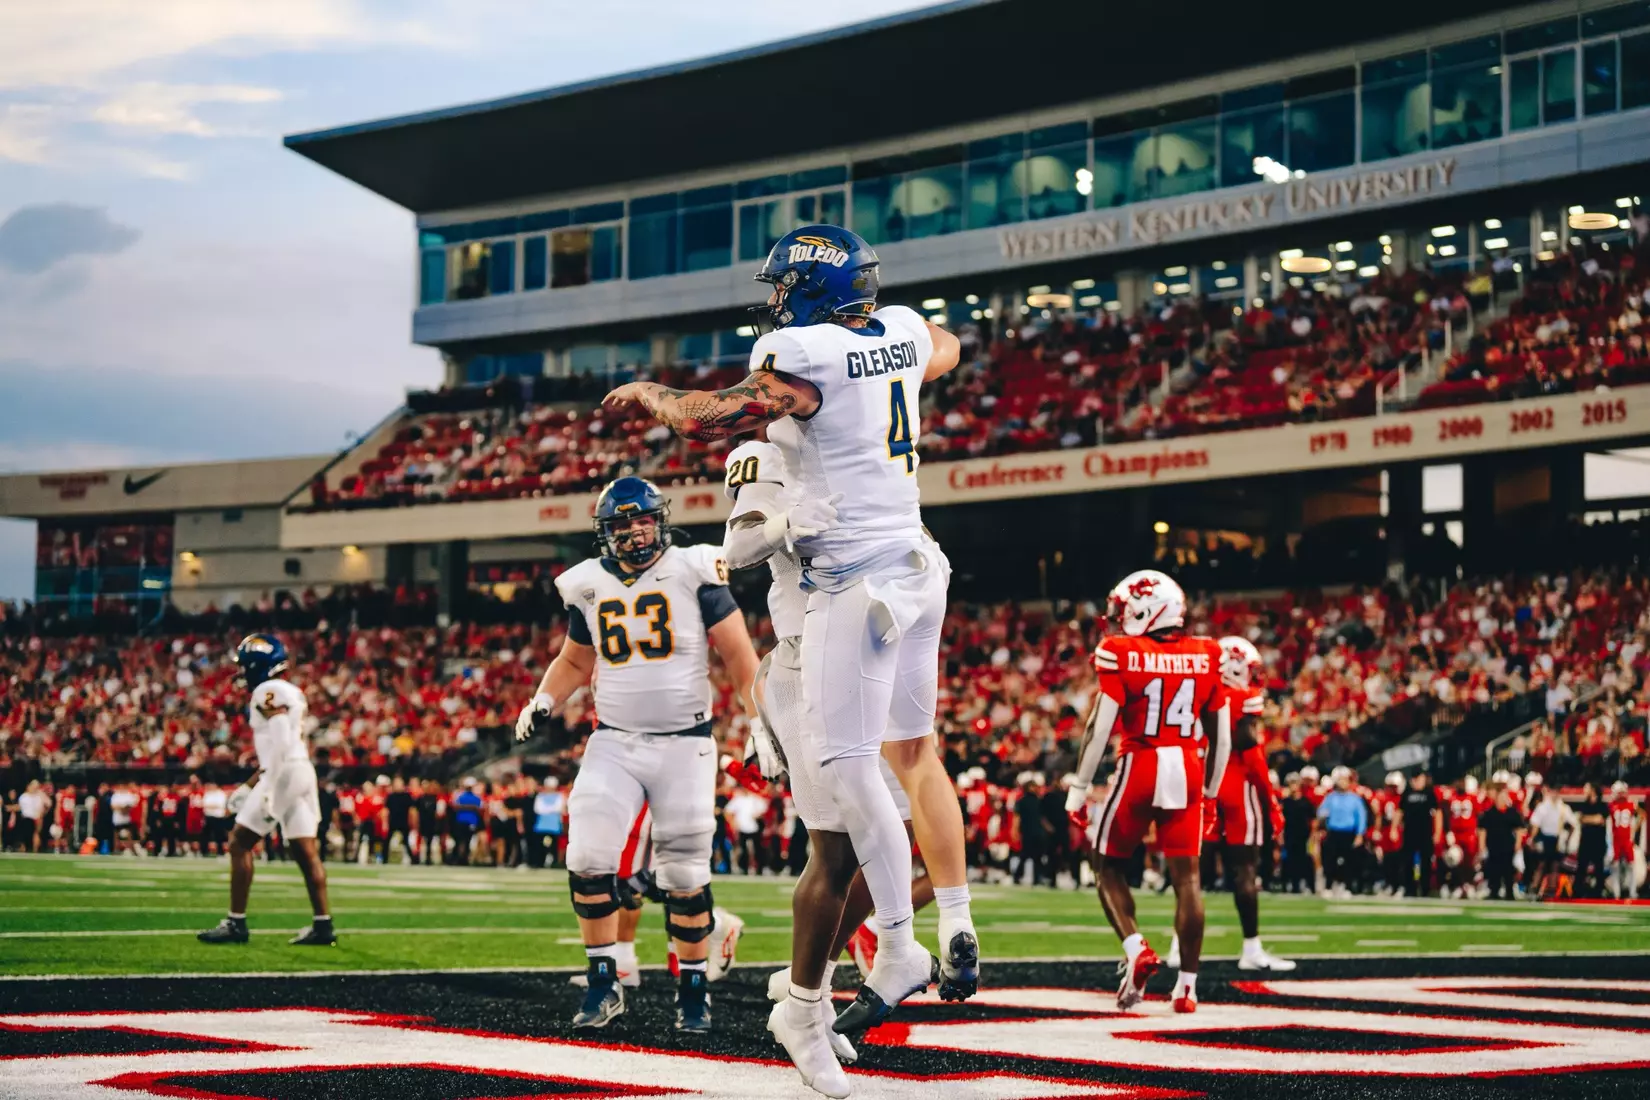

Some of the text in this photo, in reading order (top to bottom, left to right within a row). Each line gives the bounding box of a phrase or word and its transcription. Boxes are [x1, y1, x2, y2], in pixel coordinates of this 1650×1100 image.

[1001, 156, 1458, 260] WESTERN KENTUCKY UNIVERSITY
[788, 243, 850, 268] TOLEDO
[846, 340, 918, 379] GLEASON
[886, 376, 916, 477] 4
[1438, 415, 1484, 441] 2000
[1509, 407, 1555, 434] 2002
[1581, 398, 1627, 425] 2015
[728, 455, 759, 488] 20
[948, 446, 1210, 491] Conference Champions
[598, 590, 676, 668] 63
[1127, 650, 1210, 674] D. MATHEWS
[1142, 677, 1197, 738] 14
